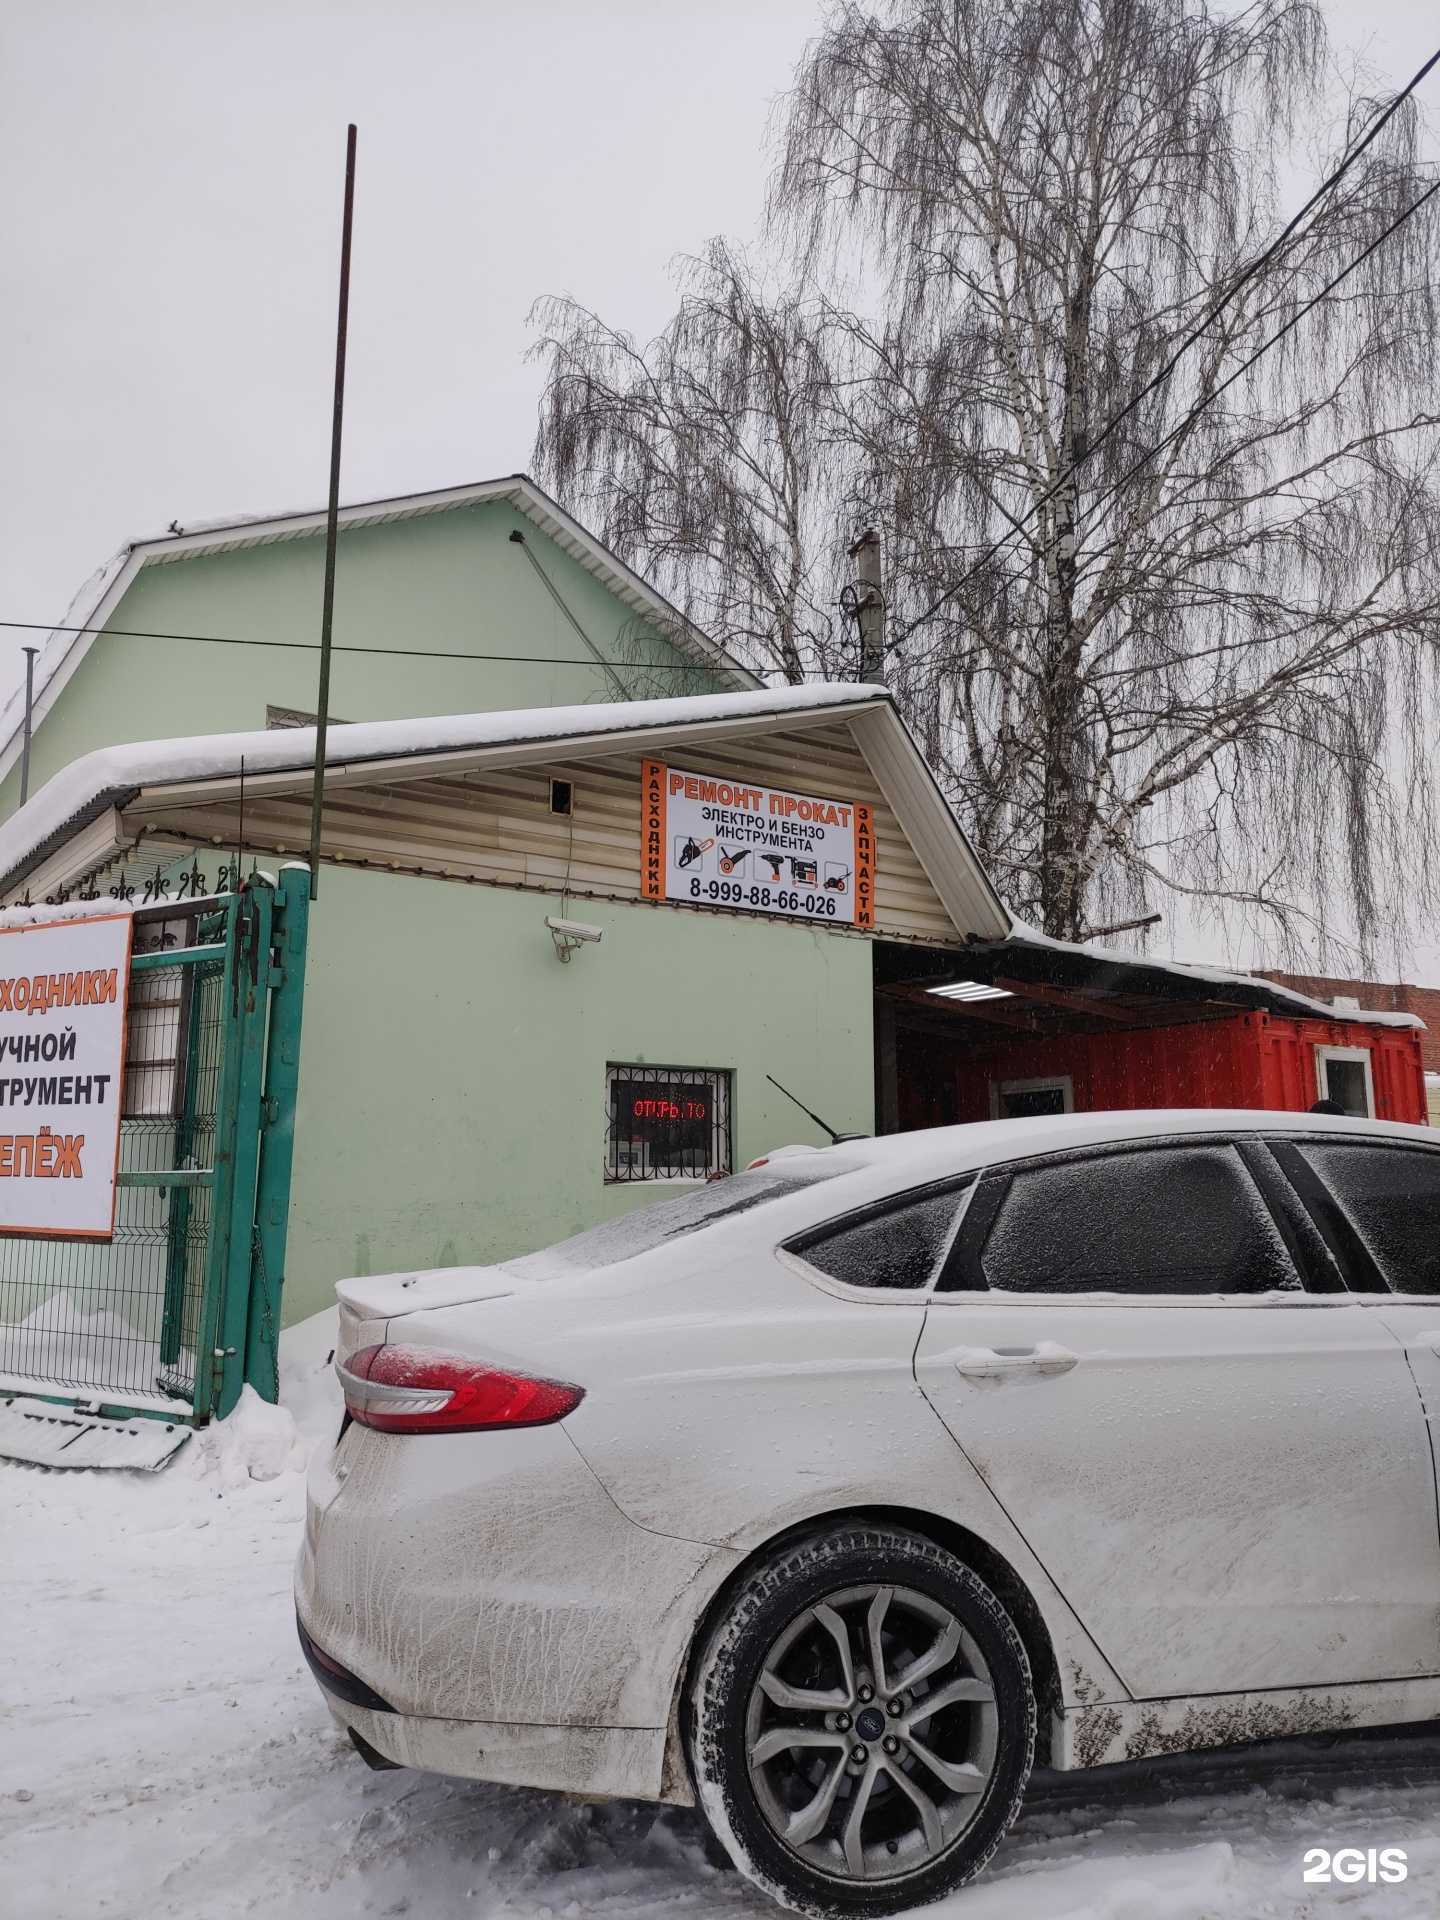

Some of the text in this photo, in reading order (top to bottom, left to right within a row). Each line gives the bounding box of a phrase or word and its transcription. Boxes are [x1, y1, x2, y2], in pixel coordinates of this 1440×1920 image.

[669, 773, 852, 828] РЕМОНТ ПРОКАТ
[702, 807, 825, 840] ЭЛЕКТРО И БЕНЗО
[647, 766, 660, 895] РАСХОДНИКИ
[715, 824, 813, 852] ИНСТРУМЕНТА
[857, 808, 870, 923] ЗАПЧАСТИ
[690, 877, 836, 916] 8-999-88-66-026
[0, 968, 118, 1016] ХОДНИКИ
